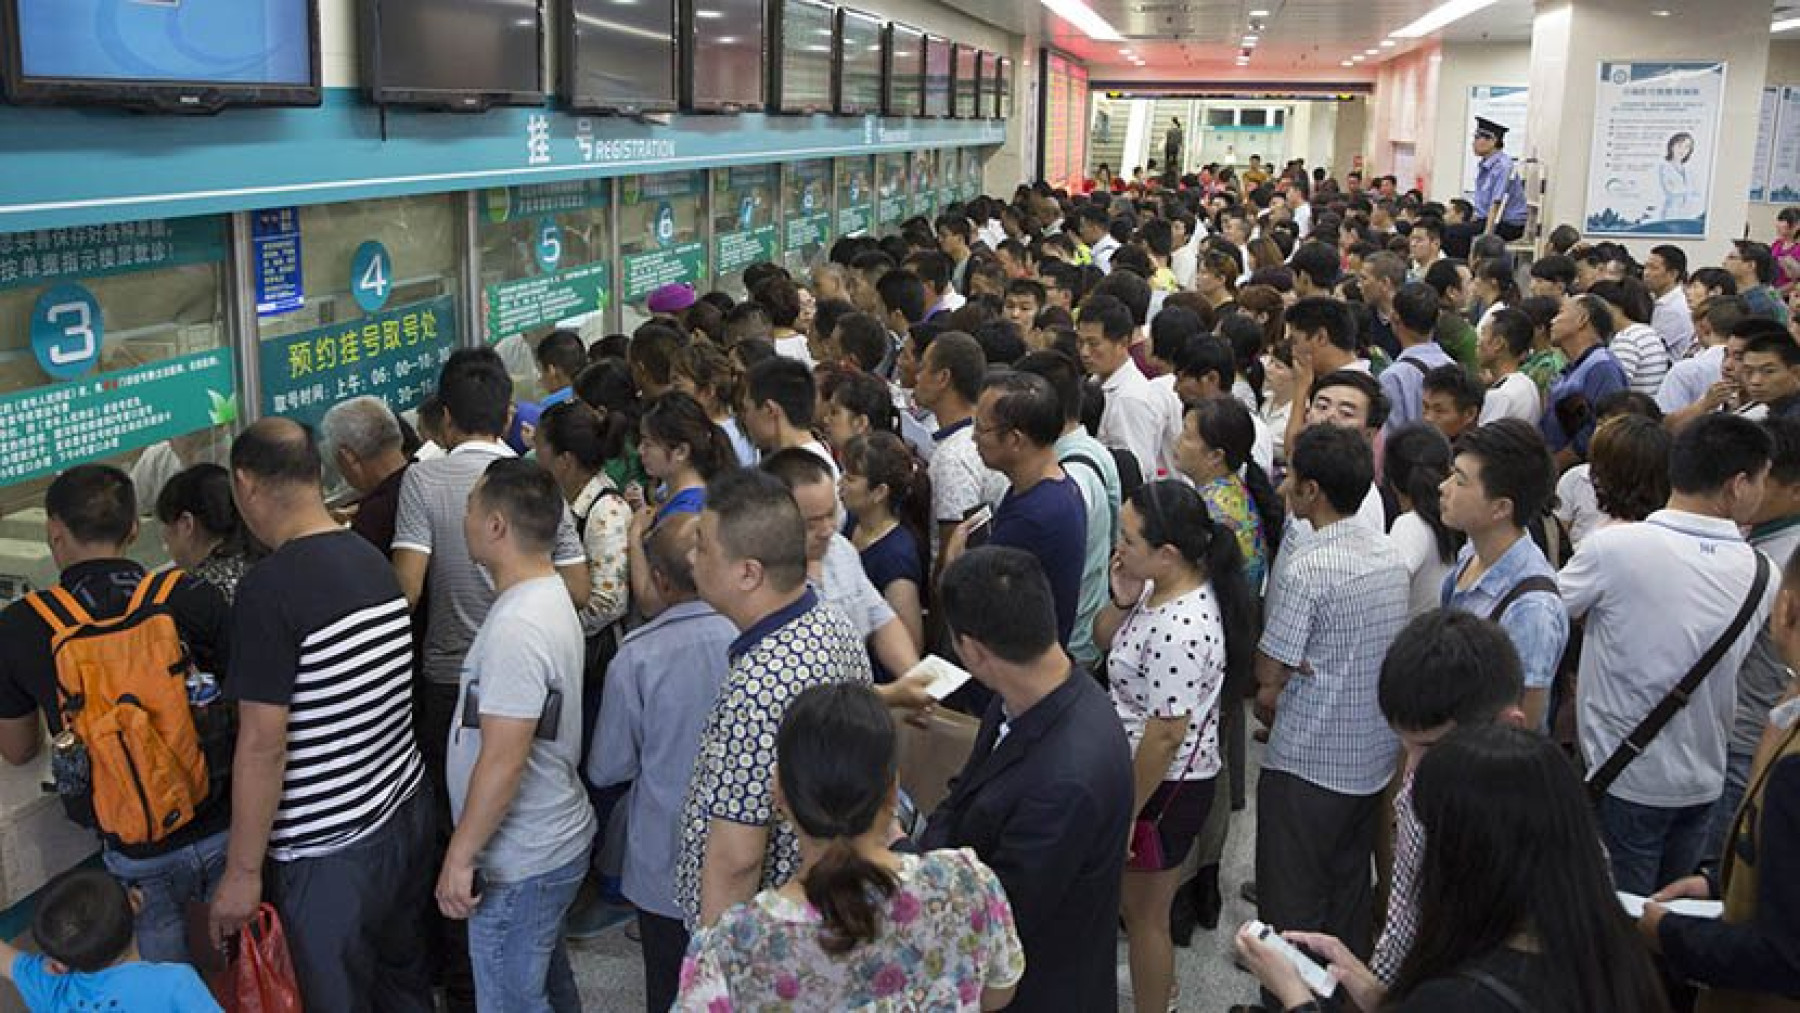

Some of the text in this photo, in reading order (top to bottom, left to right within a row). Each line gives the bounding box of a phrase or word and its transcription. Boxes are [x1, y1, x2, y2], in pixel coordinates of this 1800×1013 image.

[595, 139, 677, 161] REGISTRATION
[659, 208, 673, 239] 6
[542, 227, 561, 263] 5
[360, 253, 387, 297] 4
[47, 301, 95, 365] 3
[288, 308, 438, 379] 预约挂号取号处
